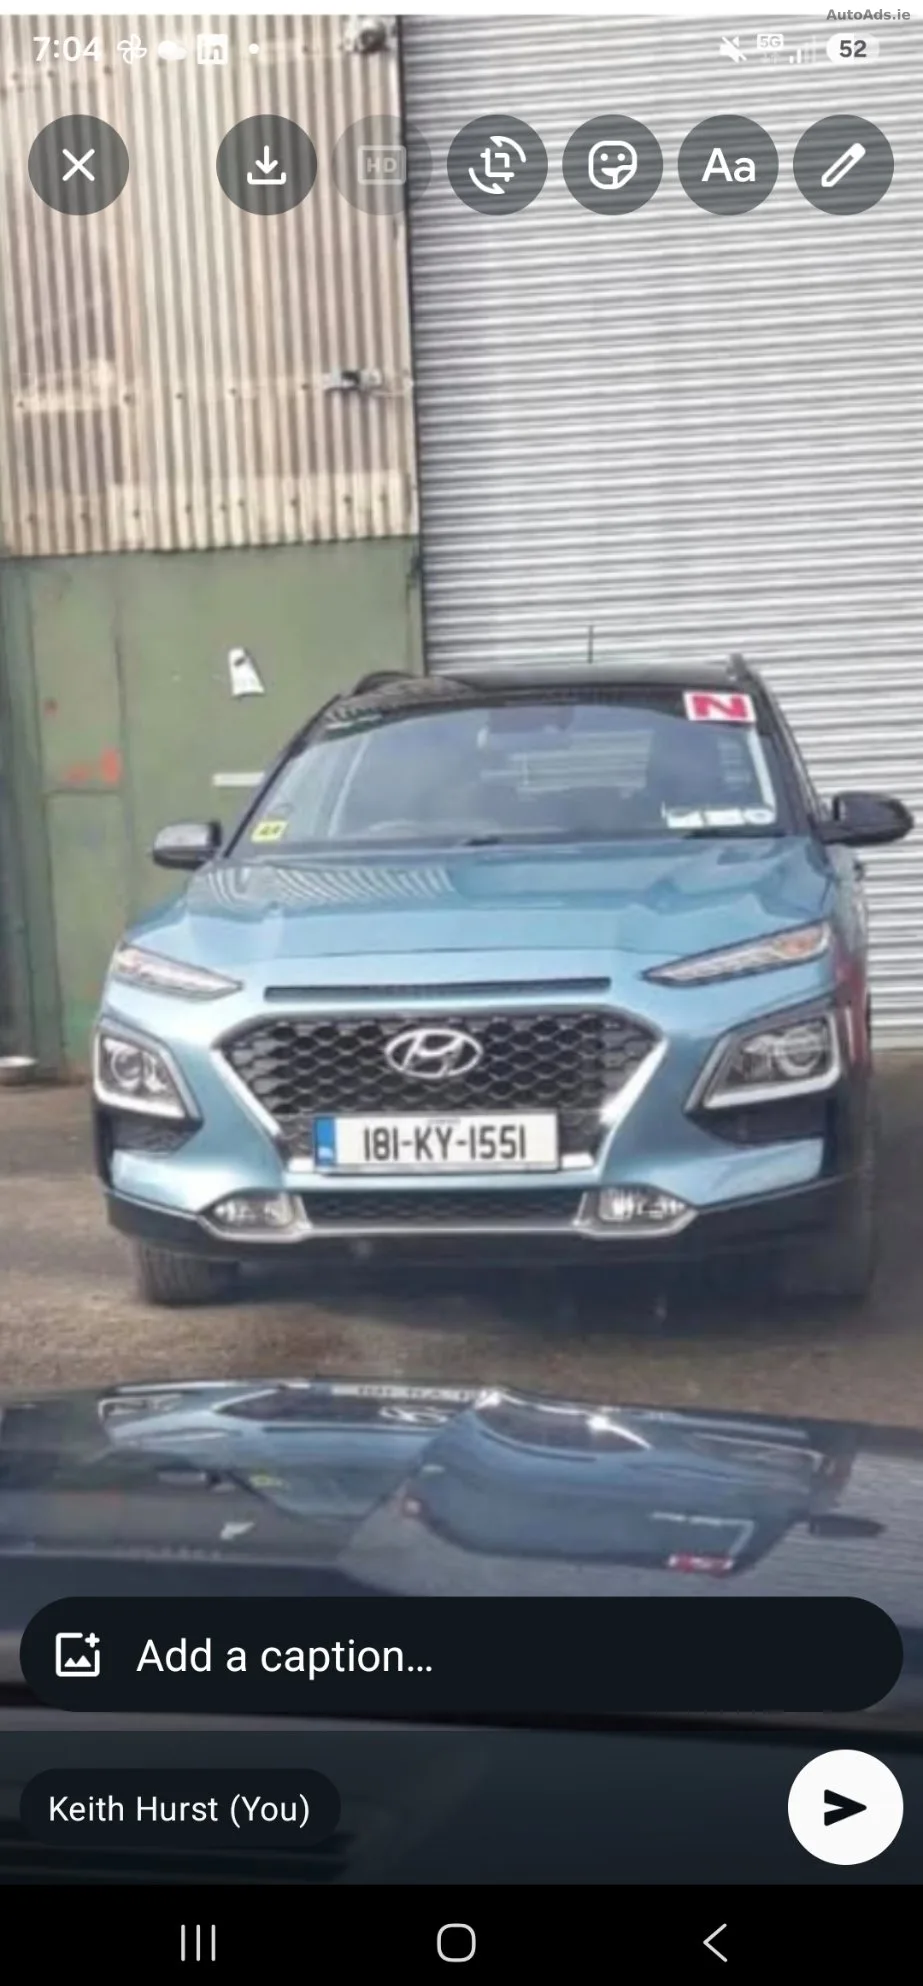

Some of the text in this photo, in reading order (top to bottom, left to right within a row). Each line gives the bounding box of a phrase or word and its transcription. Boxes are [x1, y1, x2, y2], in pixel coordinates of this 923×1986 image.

[33, 36, 101, 62] 7:04
[759, 35, 782, 49] 5G
[839, 39, 868, 58] 52
[366, 157, 398, 174] HD
[701, 147, 757, 182] Aa
[692, 693, 749, 719] N
[363, 1123, 527, 1162] 181-KY-1551
[136, 1637, 212, 1673] Add
[226, 1645, 248, 1673] a
[49, 1793, 310, 1829] Keith Hurst (You)
